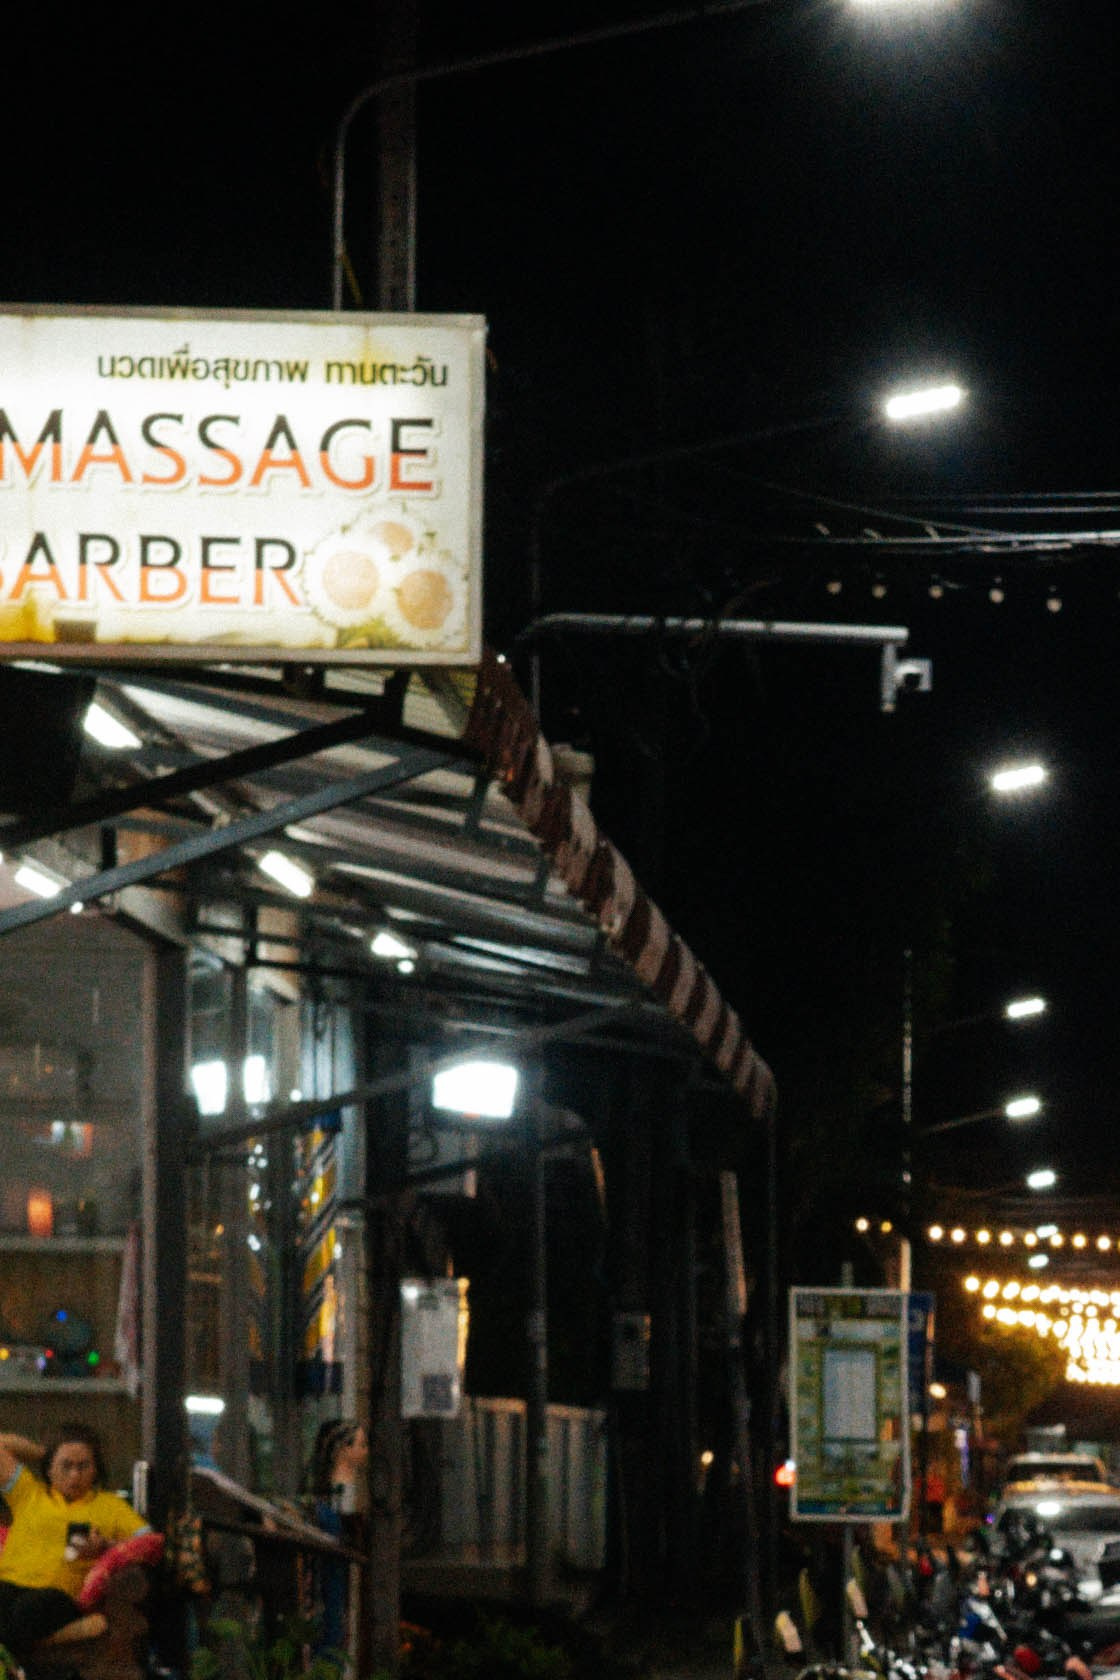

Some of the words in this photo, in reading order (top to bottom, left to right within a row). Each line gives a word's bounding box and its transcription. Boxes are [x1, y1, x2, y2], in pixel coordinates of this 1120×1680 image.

[325, 355, 448, 387] ทานตะวัน
[0, 408, 434, 491] MASSAGE
[0, 531, 301, 605] ARBER
